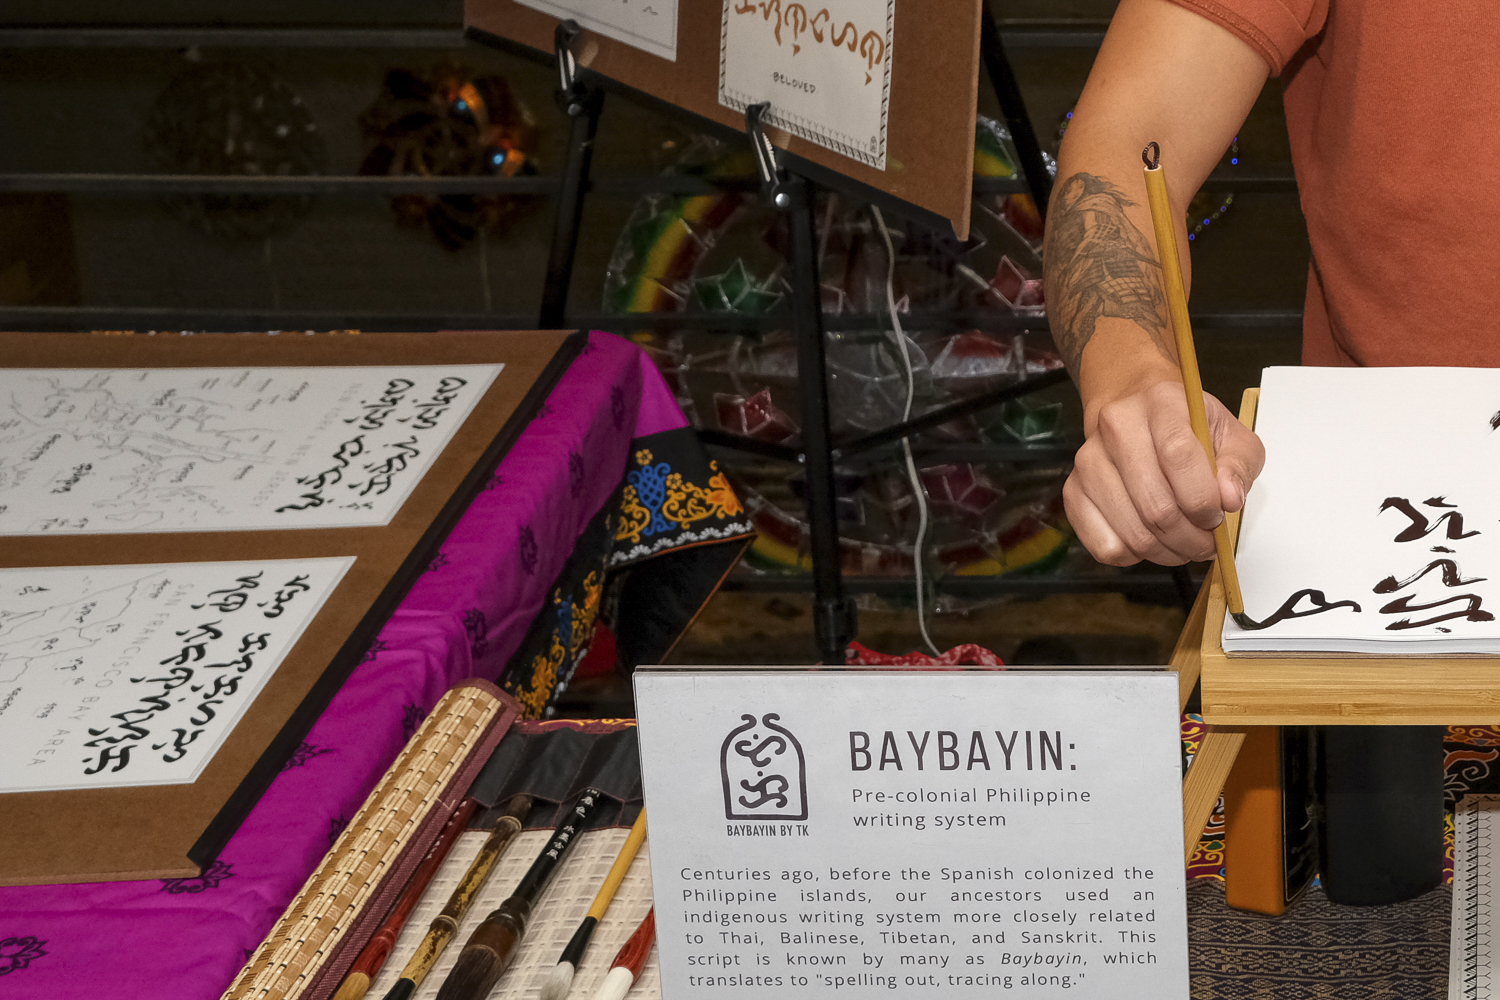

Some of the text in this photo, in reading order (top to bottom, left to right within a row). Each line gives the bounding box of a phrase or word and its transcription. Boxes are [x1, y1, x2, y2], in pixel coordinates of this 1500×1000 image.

[773, 71, 817, 95] BELOVED
[68, 696, 100, 720] BAY
[27, 729, 71, 766] AREA
[849, 730, 1077, 772] BAYBAYIN:
[852, 787, 1091, 807] Pre-colonial Philippine
[726, 824, 809, 837] BAYBAYIN BY TK
[852, 812, 1006, 831] writing system
[680, 866, 1154, 884] Centuries ago, before the Spanish colonized the
[682, 887, 1155, 906] Philippine islands, our ancestors used an
[684, 909, 1155, 927] indigenous writing system more closely related
[685, 930, 1157, 946] to Thai, Balinese, Tibetan, and Sanskrit. This
[687, 951, 1157, 969] script is known by many as Baybayin, which
[689, 972, 1085, 990] translates to "spelling out, tracing along."
